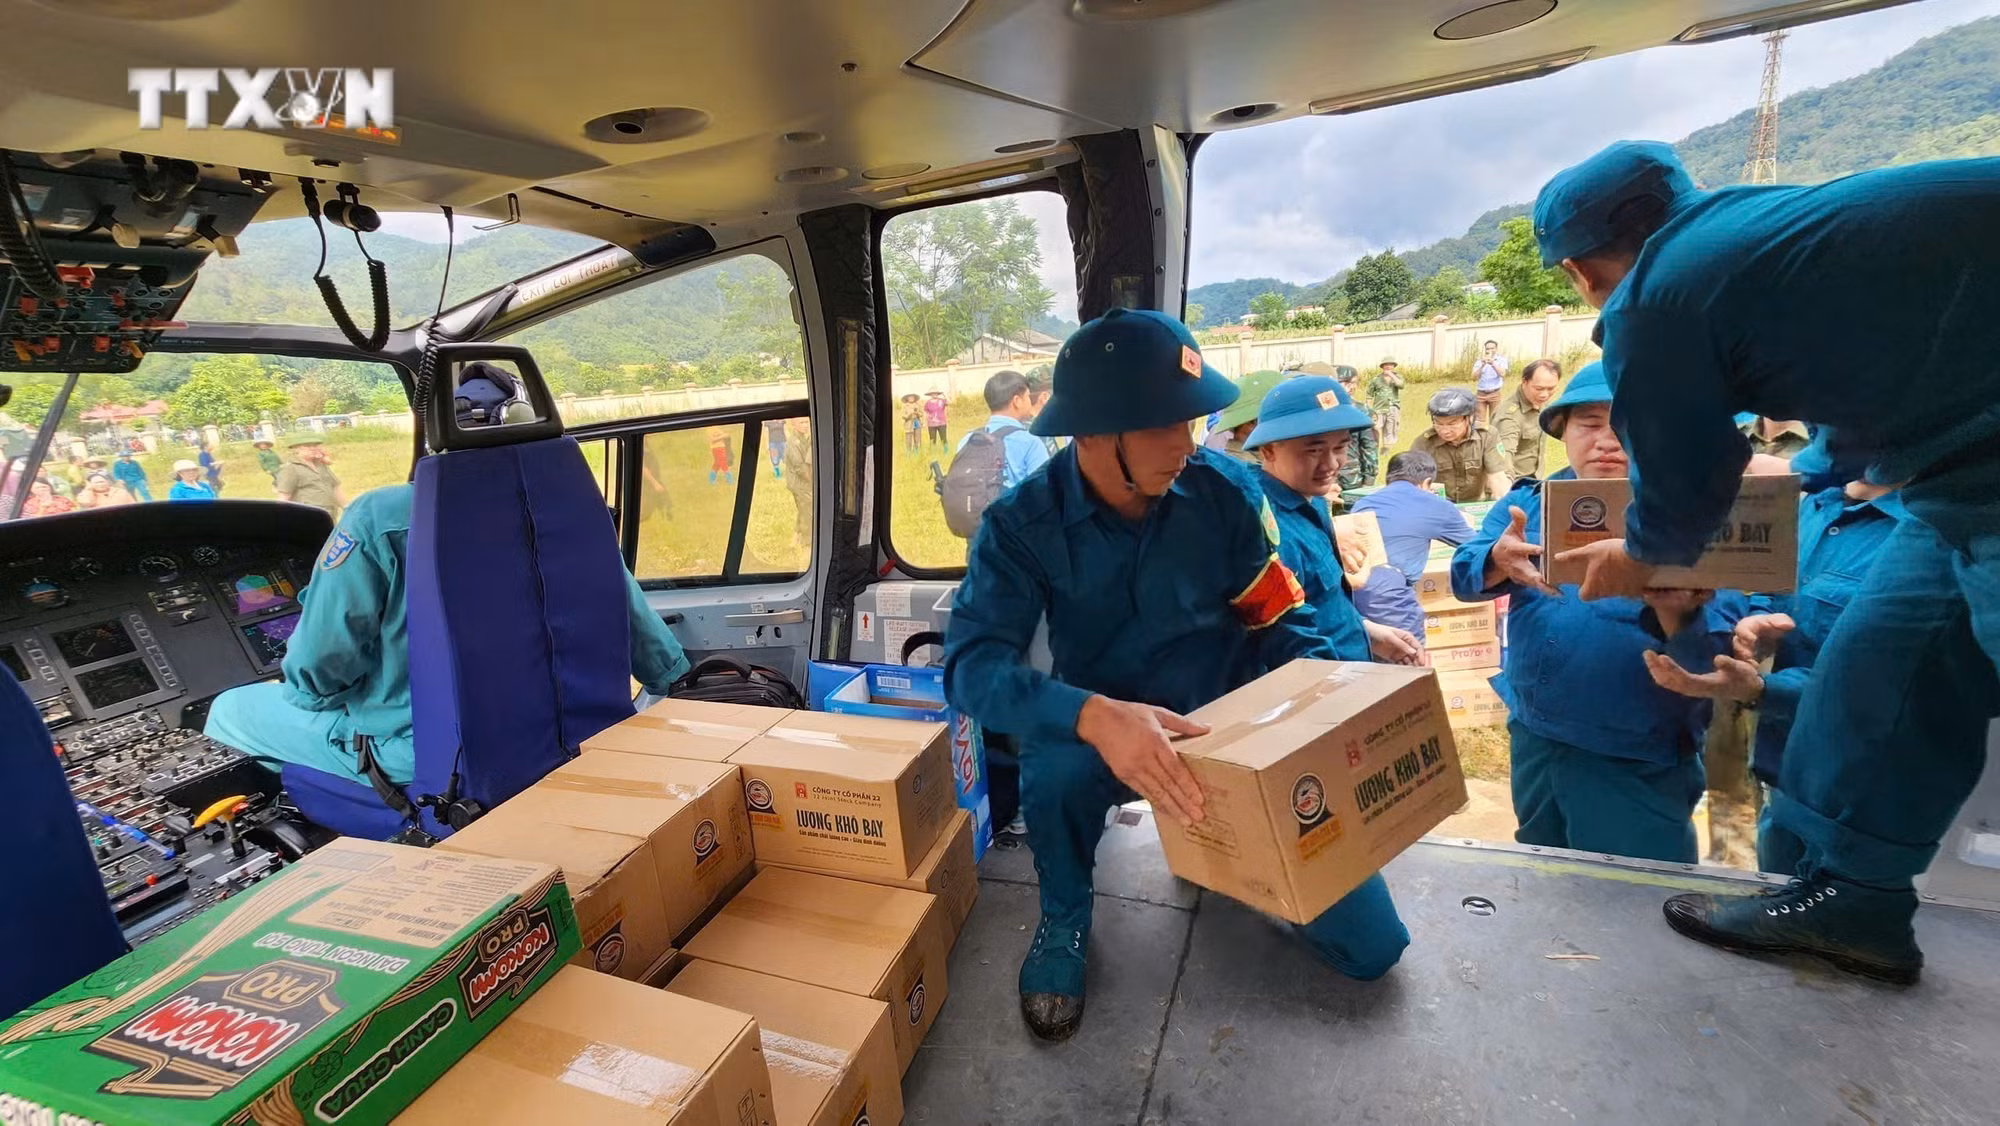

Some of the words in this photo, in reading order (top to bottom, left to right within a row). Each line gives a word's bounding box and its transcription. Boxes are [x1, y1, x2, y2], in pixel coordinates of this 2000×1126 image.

[1740, 522, 1774, 544] BAY
[1393, 748, 1420, 786] KHÔ
[1419, 735, 1442, 769] BAY
[812, 786, 831, 795] CÔNG
[872, 794, 881, 802] 22
[837, 796, 853, 804] Stock
[854, 799, 882, 809] Company
[796, 809, 832, 832] LƯƠNG
[834, 814, 859, 836] KHÔ
[862, 819, 883, 839] BAY
[486, 914, 524, 953] PRO
[322, 944, 380, 970] NGON
[376, 955, 411, 974] DAI
[470, 922, 550, 1004] KOKOMI
[240, 969, 318, 1005] PRO
[124, 995, 301, 1067] KOKOMI
[393, 1004, 453, 1060] CANH
[320, 1053, 392, 1114] CHUA
